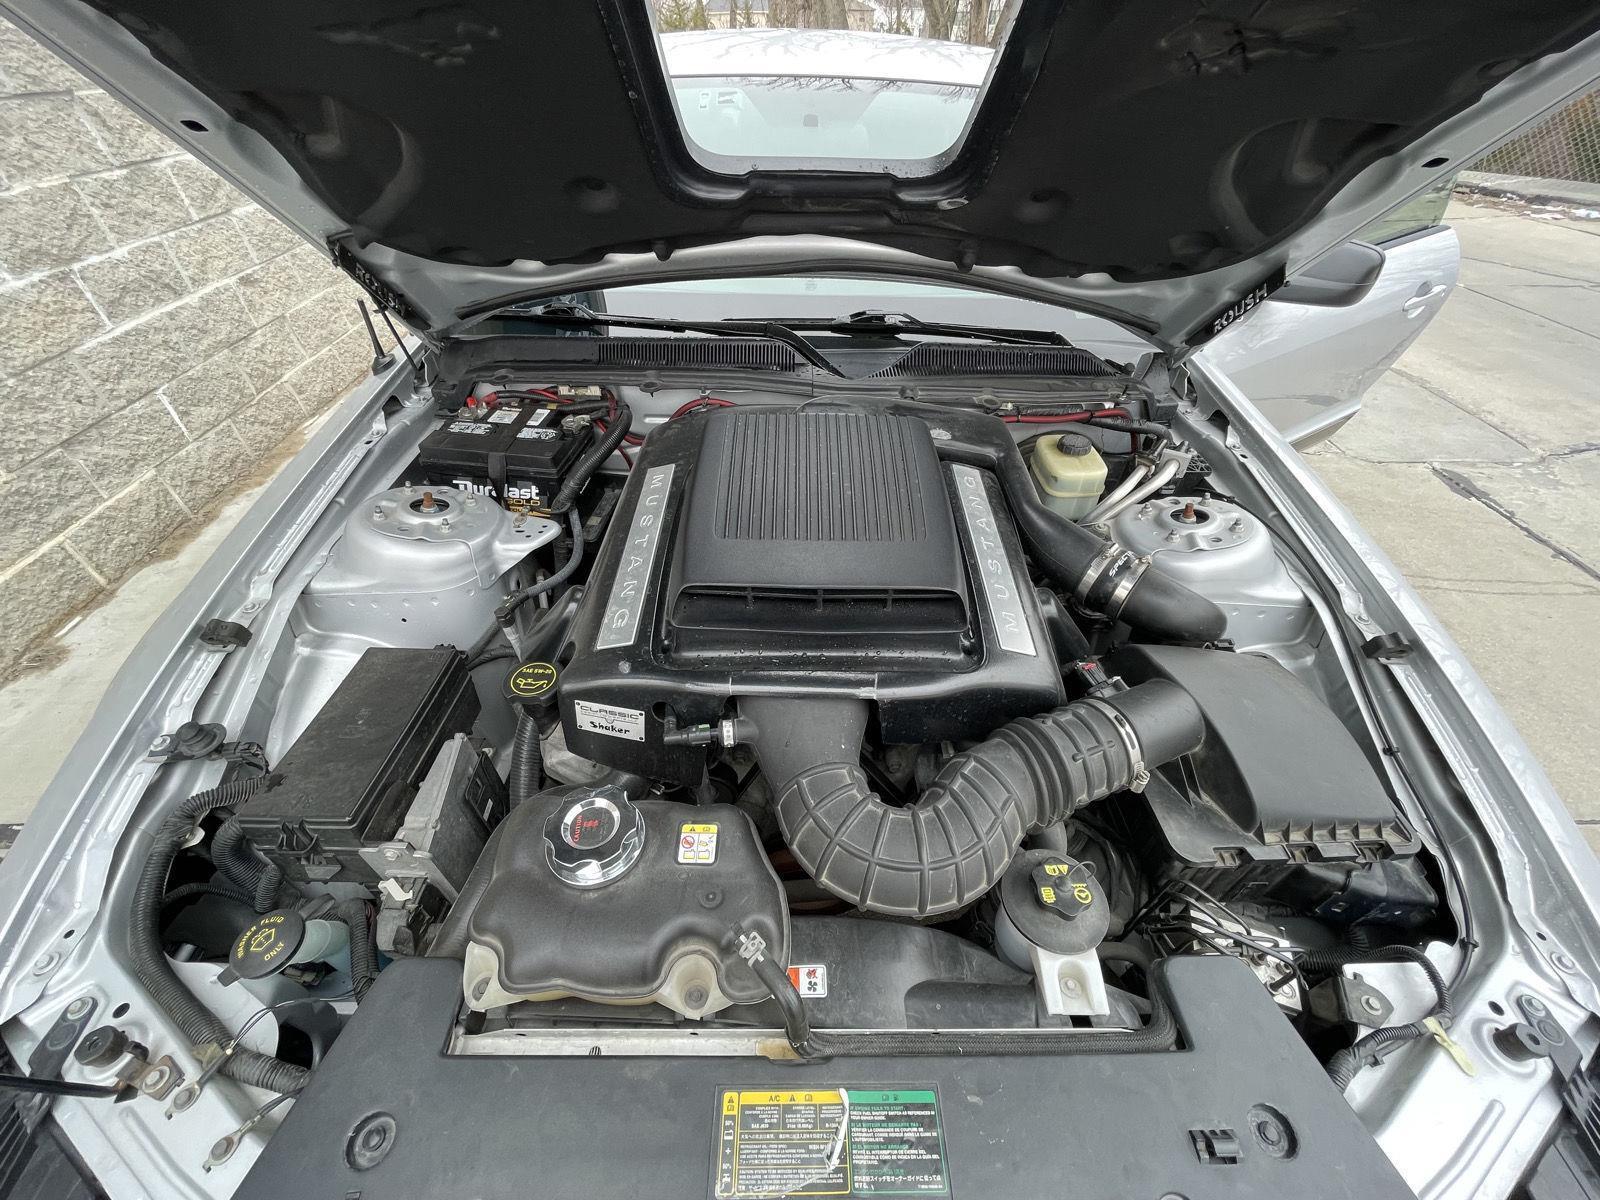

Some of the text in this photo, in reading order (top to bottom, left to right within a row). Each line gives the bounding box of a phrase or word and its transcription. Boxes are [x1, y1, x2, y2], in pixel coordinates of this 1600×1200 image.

[1213, 282, 1268, 334] ROUSH
[613, 474, 665, 629] MUSTANG
[963, 476, 1020, 632] MUSTANG
[1108, 550, 1137, 578] SPECT
[580, 705, 640, 720] CLASSIC
[589, 721, 631, 735] Shaker
[573, 814, 583, 842] CAUTION
[237, 916, 285, 959] WASHER FLUID
[264, 940, 285, 961] ONLY
[768, 1094, 781, 1103] A/C
